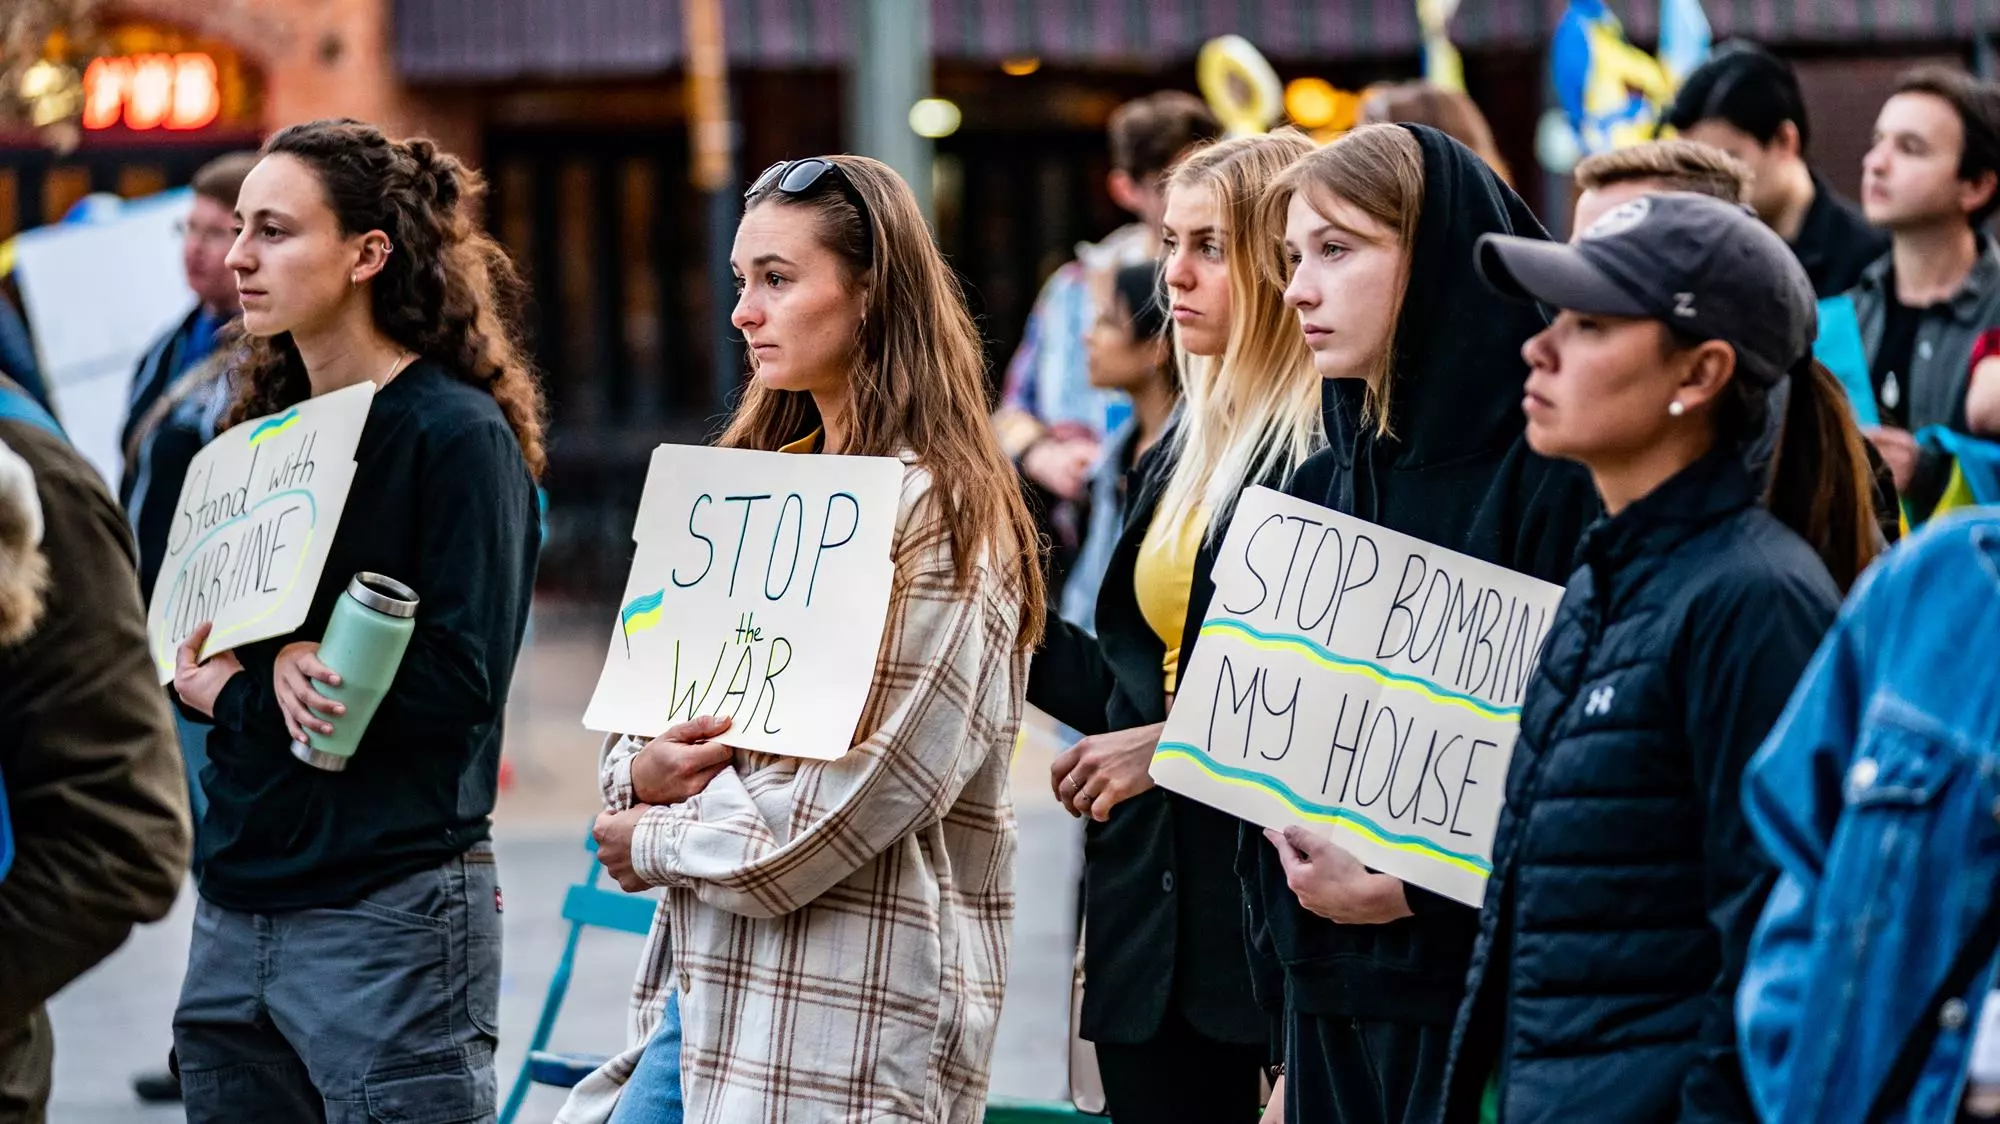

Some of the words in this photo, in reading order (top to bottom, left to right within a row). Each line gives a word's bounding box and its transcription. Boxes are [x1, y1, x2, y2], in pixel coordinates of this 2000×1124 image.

[169, 443, 261, 556] Stand
[268, 430, 317, 492] with
[672, 492, 859, 608] STOP
[171, 506, 301, 644] UKRAINE
[735, 612, 764, 645] the
[1223, 514, 1379, 646] STOP
[1376, 554, 1546, 704] BOMBIN
[667, 637, 792, 734] WAR
[1208, 655, 1302, 761] MY
[1321, 693, 1498, 837] HOUSE
